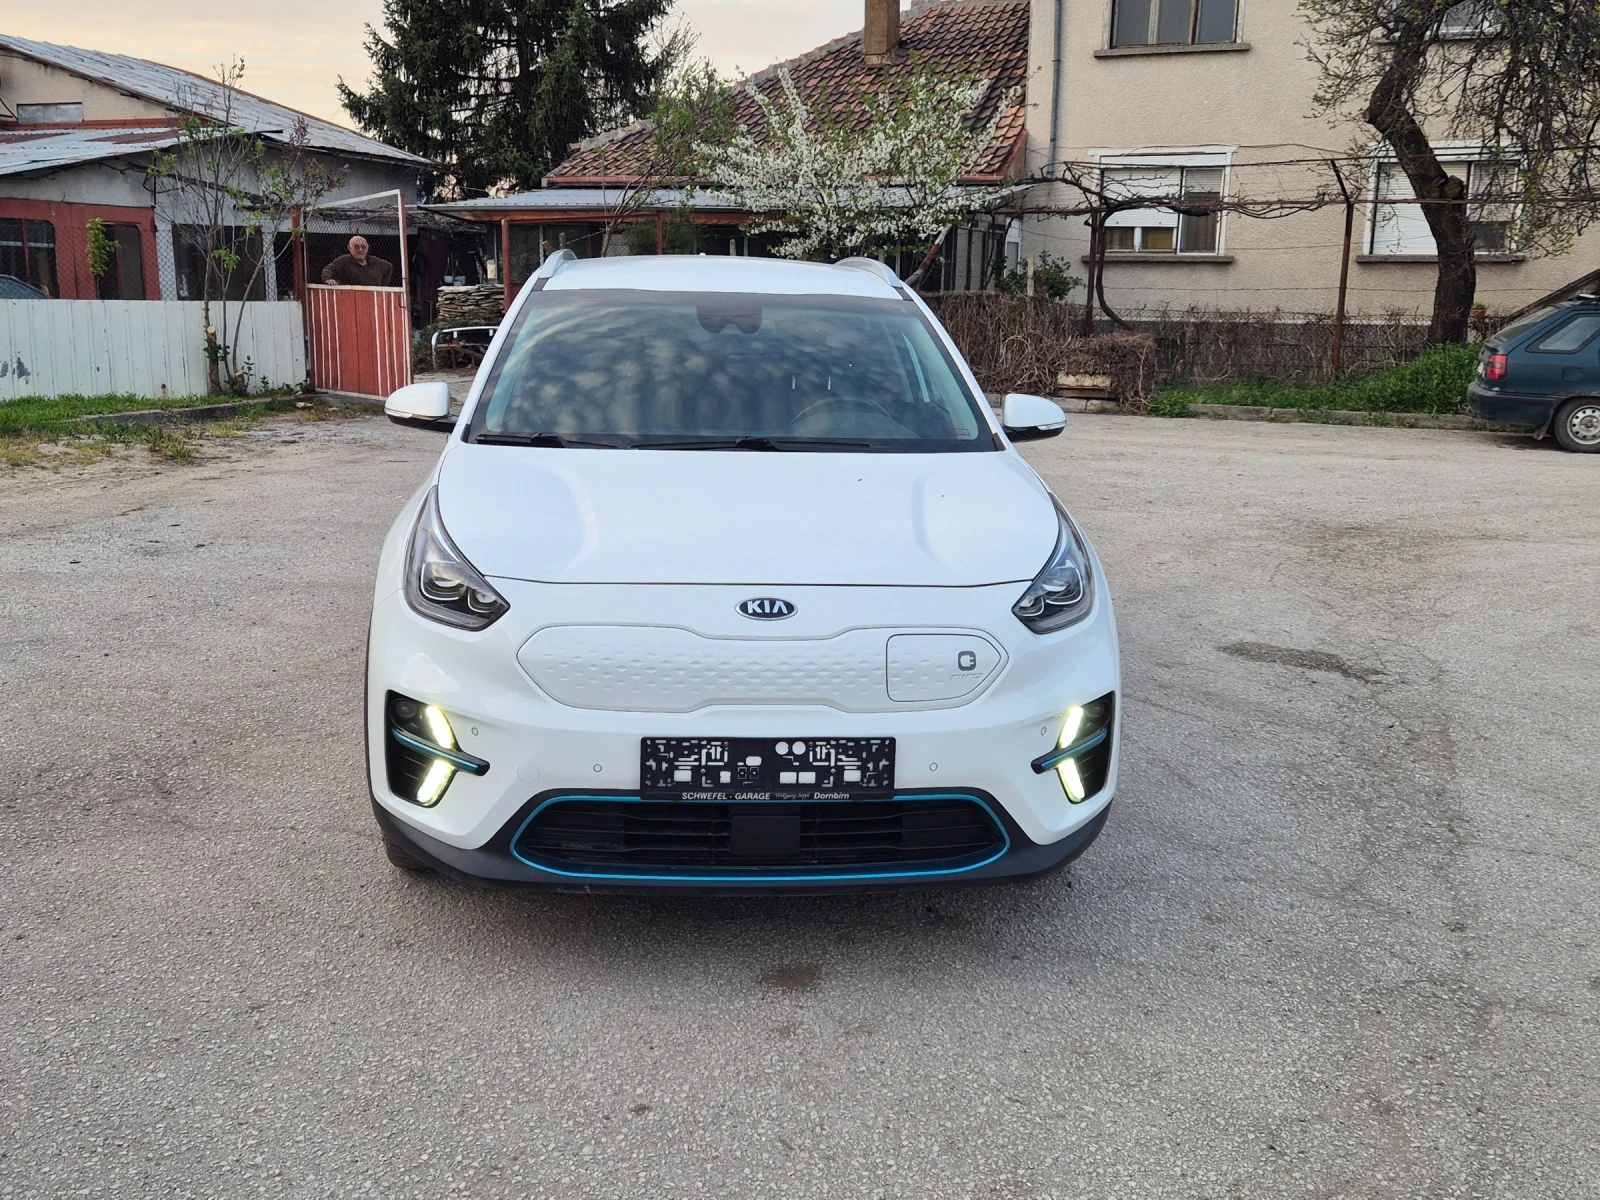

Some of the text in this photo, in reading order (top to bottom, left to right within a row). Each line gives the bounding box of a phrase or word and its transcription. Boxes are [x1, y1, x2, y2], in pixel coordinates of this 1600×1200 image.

[747, 599, 788, 614] KIA
[681, 792, 728, 800] SCHWEFEL
[734, 792, 771, 800] GARAGE
